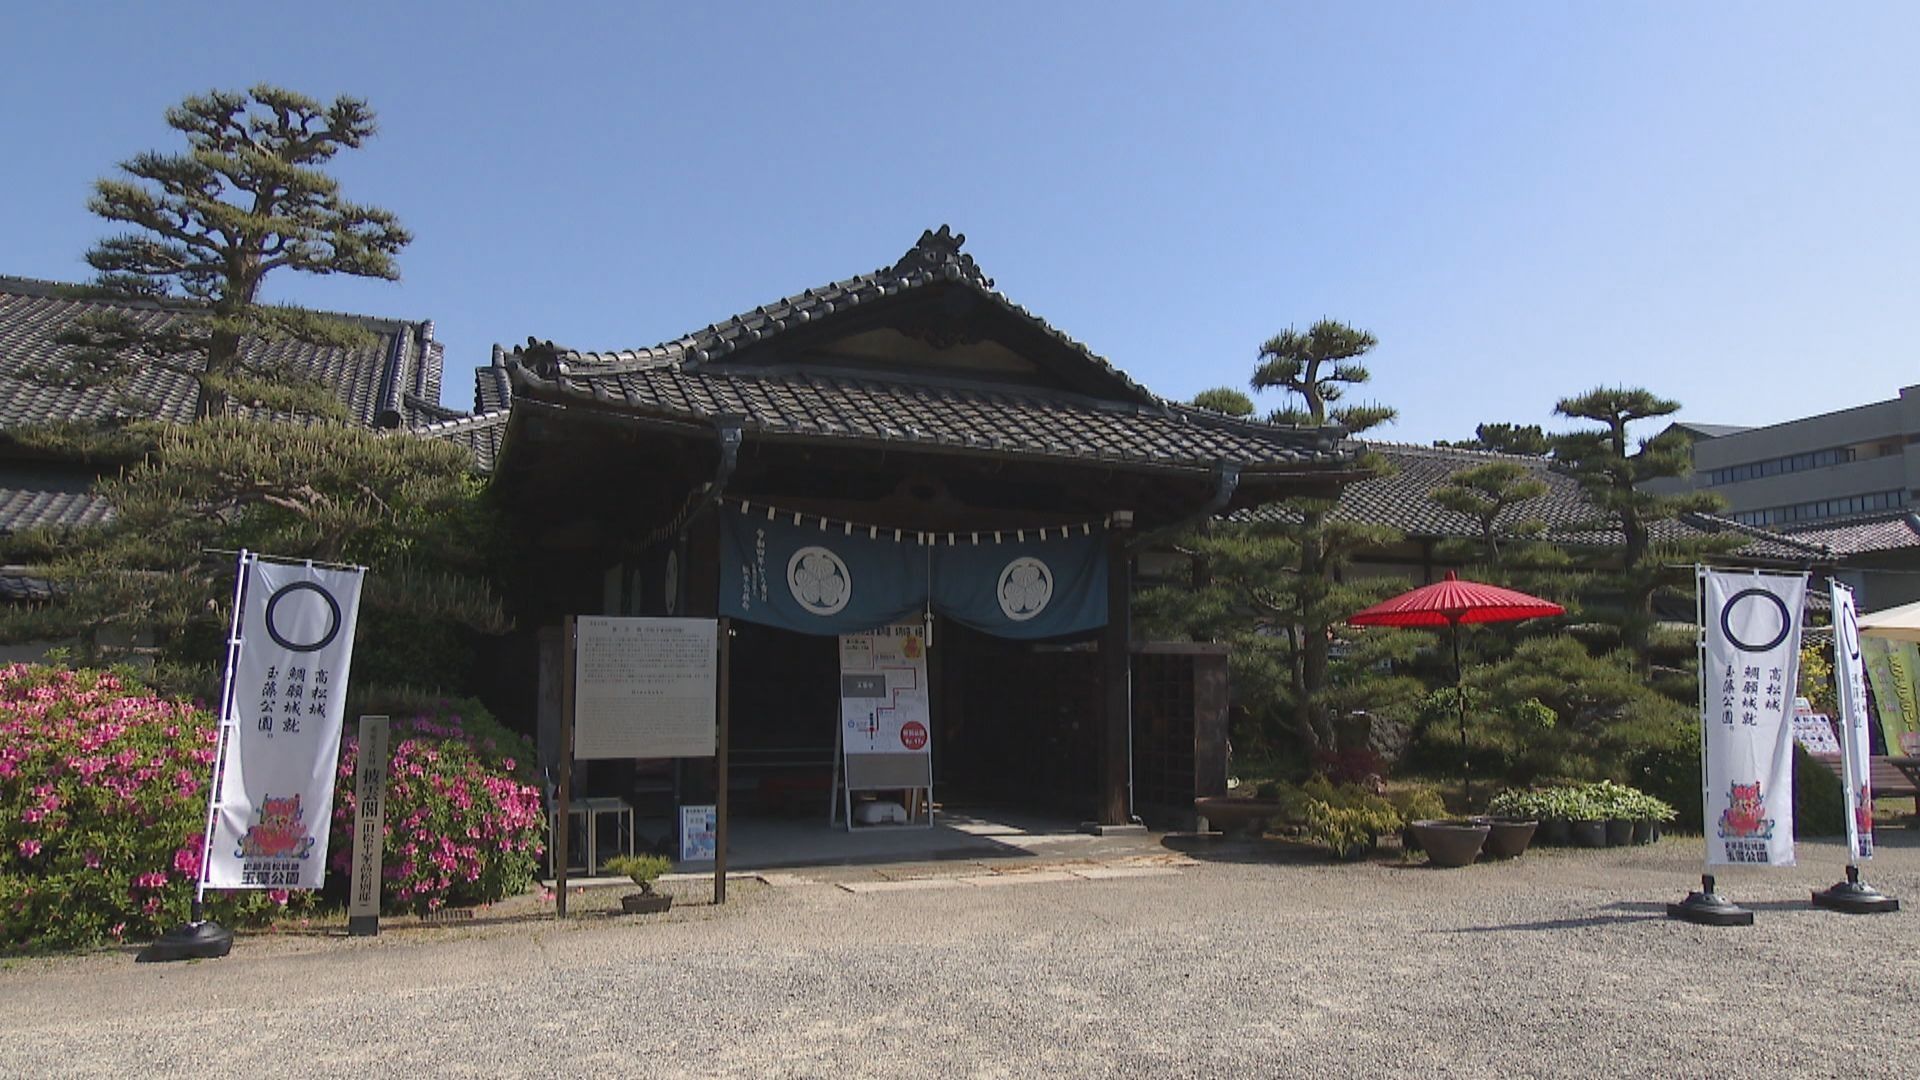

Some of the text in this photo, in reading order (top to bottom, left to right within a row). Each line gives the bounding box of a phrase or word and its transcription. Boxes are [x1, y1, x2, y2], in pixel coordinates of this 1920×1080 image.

[258, 664, 279, 732] 玉藻公園
[282, 666, 306, 733] 鯛願城就
[309, 669, 328, 718] 高松城
[1721, 664, 1735, 724] 玉藻公園
[1742, 665, 1760, 726] 鯛願城就
[1765, 666, 1782, 712] 高松城
[241, 871, 300, 885] 玉藻公園
